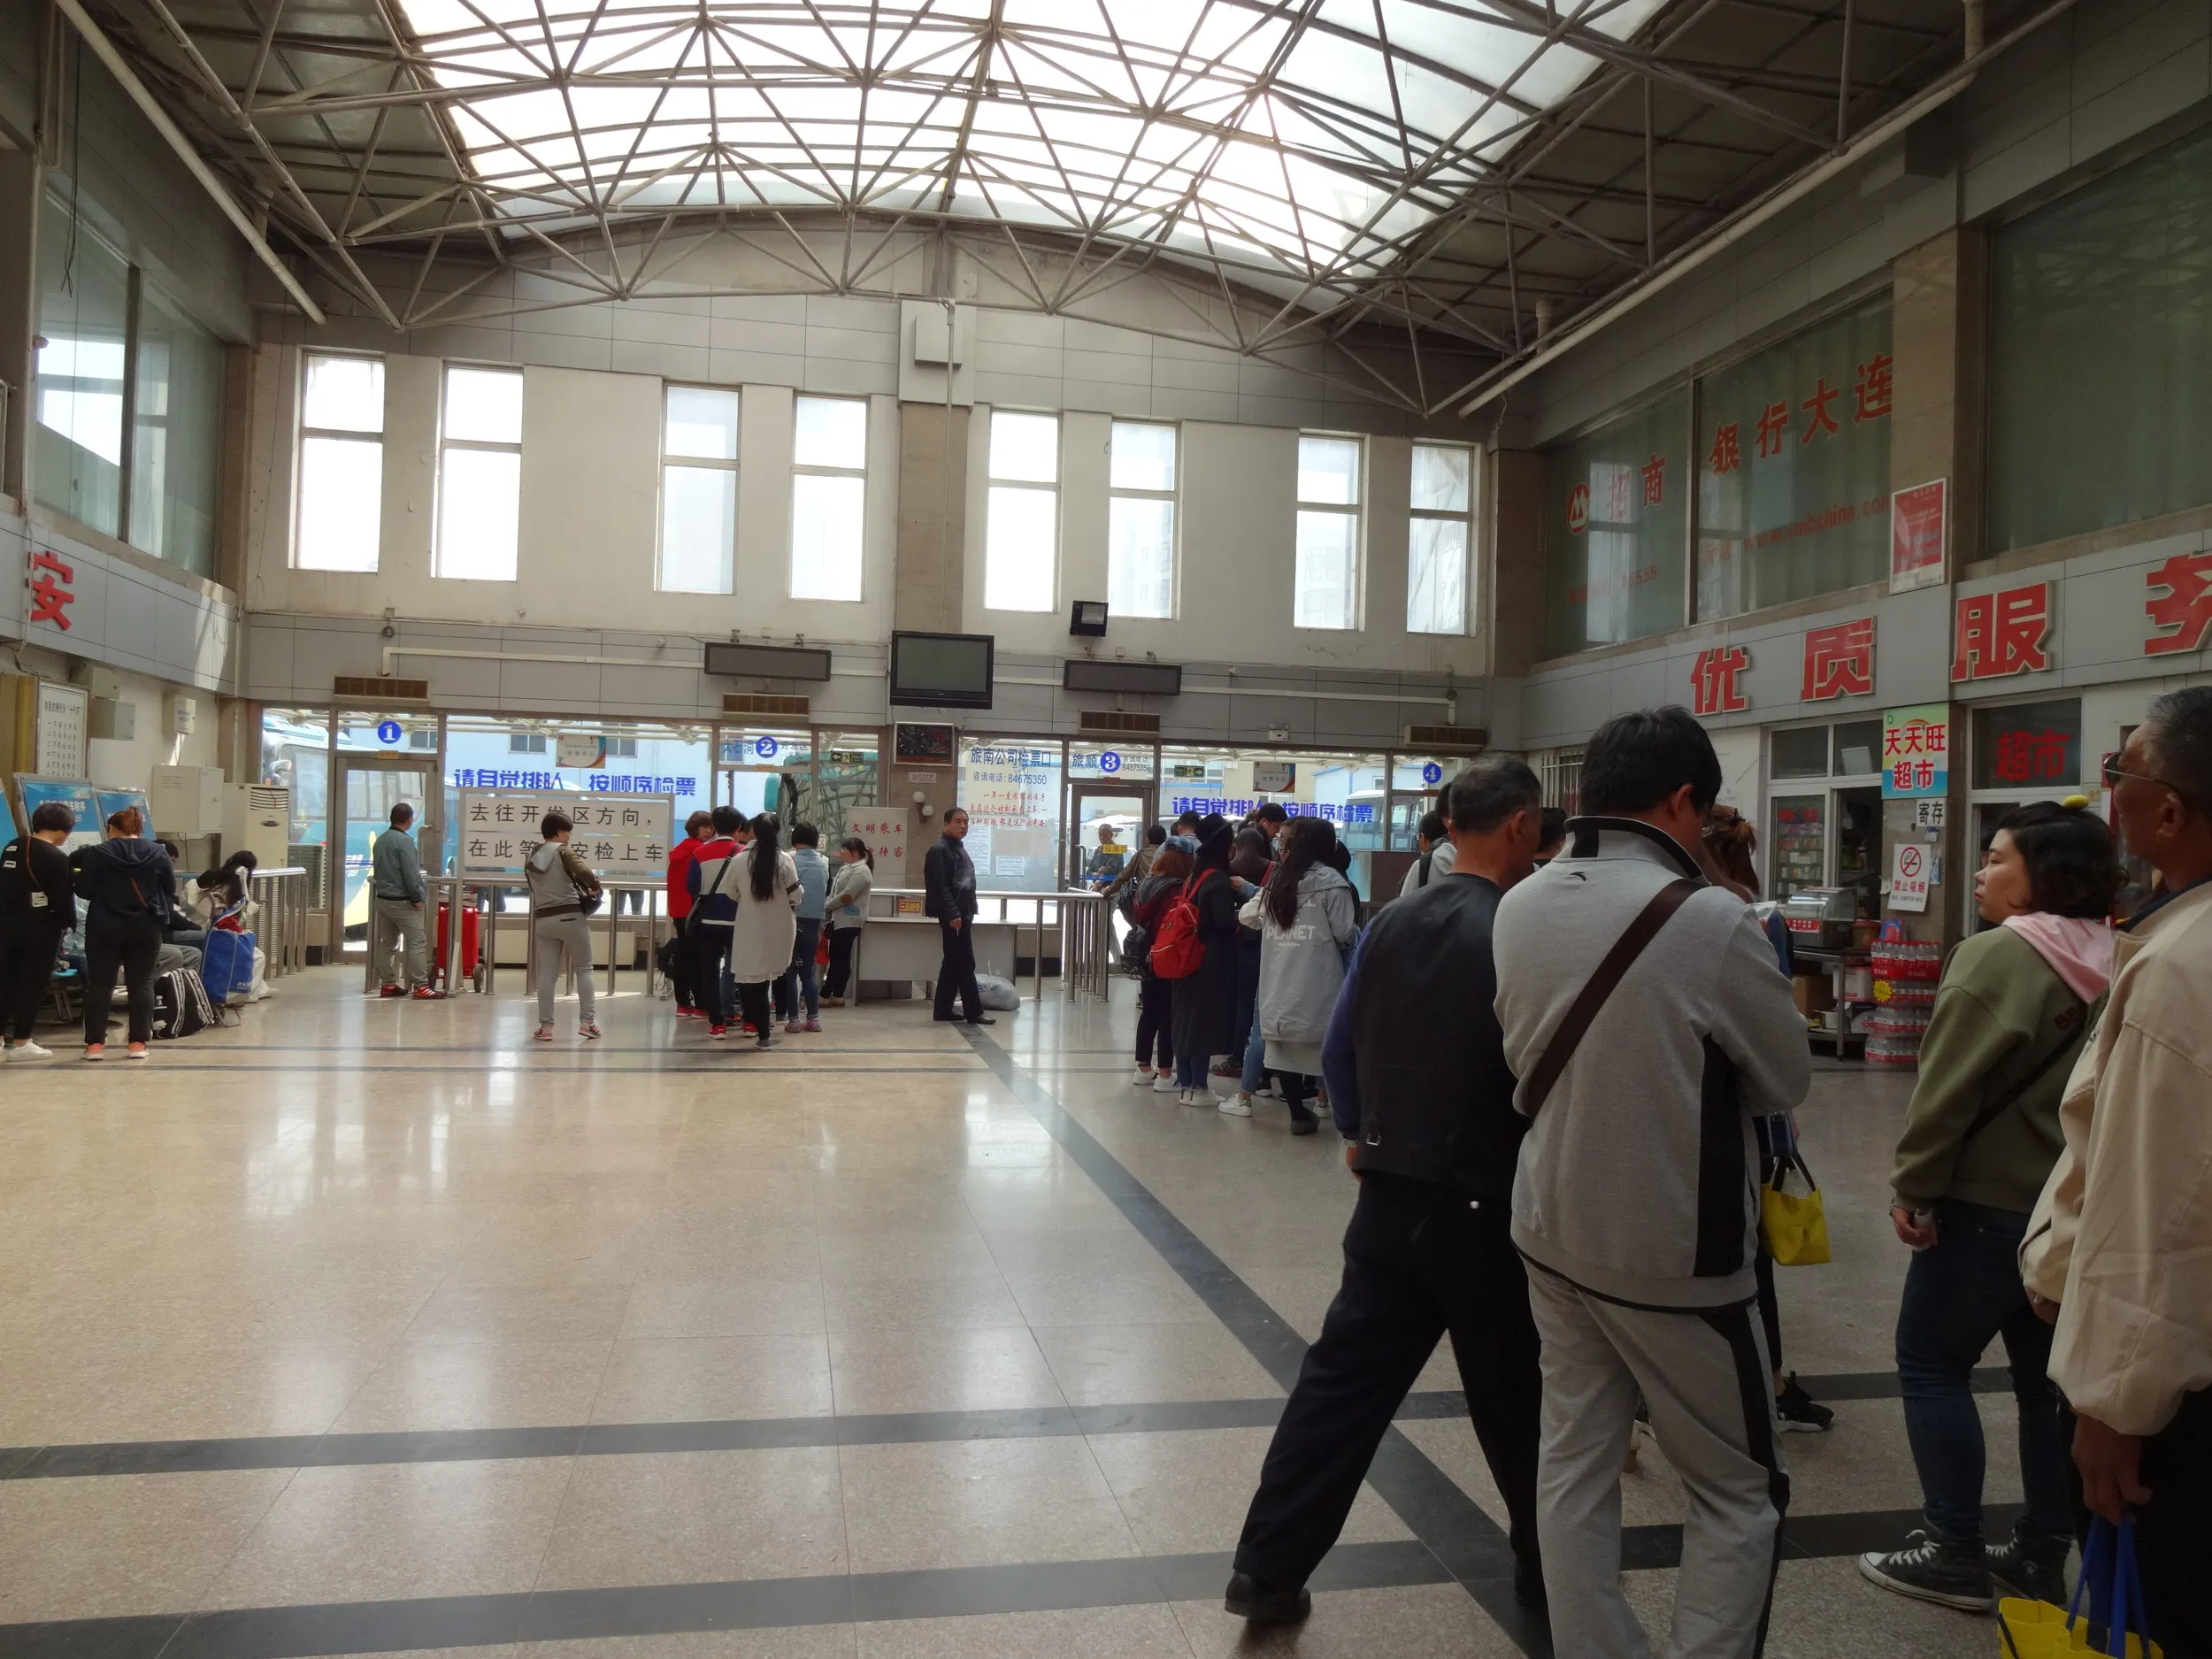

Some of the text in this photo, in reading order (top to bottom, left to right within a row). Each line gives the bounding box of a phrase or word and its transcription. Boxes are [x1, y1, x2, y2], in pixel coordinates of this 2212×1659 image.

[27, 550, 75, 631] 安
[1884, 724, 1946, 757] 天天旺
[970, 746, 1051, 767] 旅南公司检票口
[1071, 754, 1098, 768] 旅顺
[1994, 727, 2073, 781] 超市
[1122, 763, 1151, 772] 84675350
[1893, 759, 1935, 789] 超市
[588, 774, 696, 796] 按顺序检票
[1918, 801, 1944, 825] 寄存
[851, 822, 902, 834] 文明乘车
[468, 838, 663, 863] 在此等安检上车
[1893, 880, 1925, 893] 禁止吸烟
